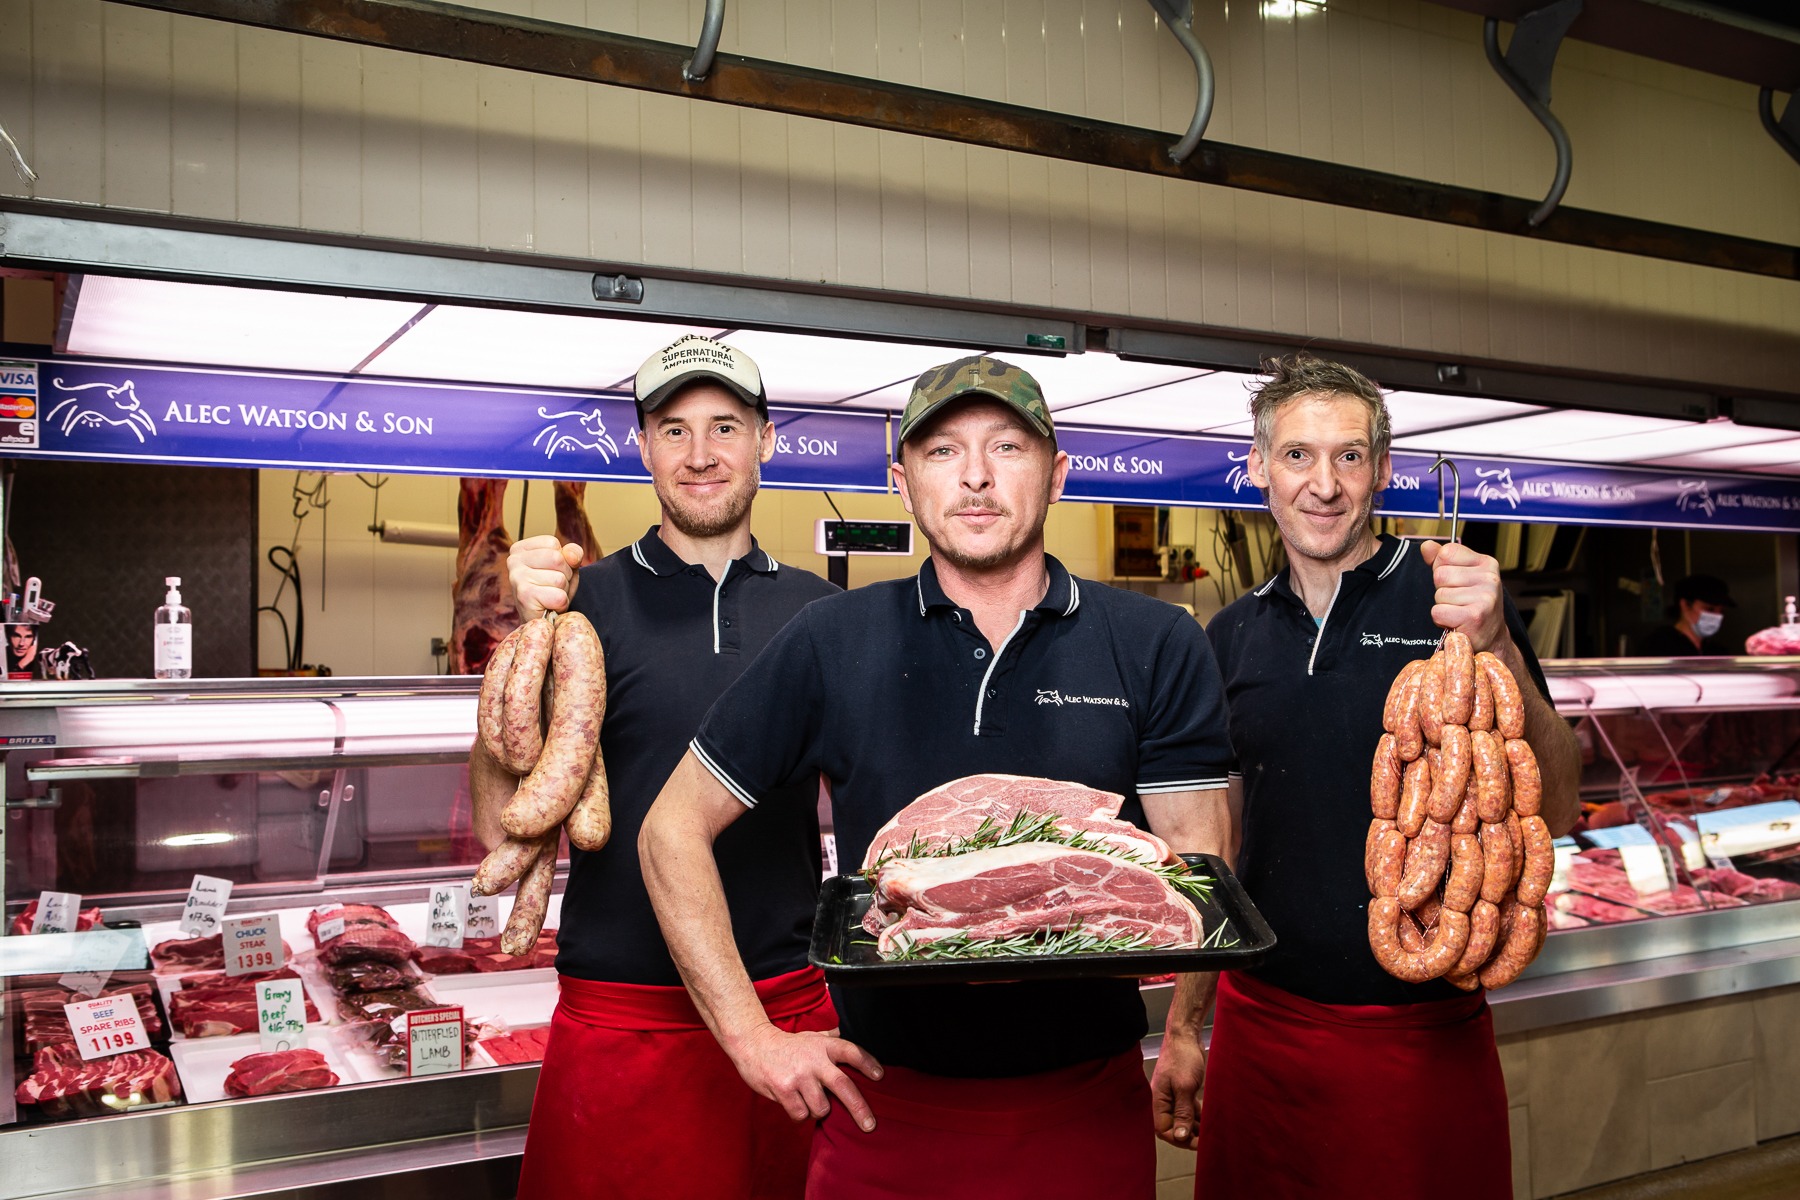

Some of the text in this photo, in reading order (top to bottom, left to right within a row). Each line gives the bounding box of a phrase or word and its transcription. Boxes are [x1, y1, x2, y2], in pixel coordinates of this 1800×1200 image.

[661, 348, 735, 364] SUPERNATURAL
[663, 357, 735, 371] AMPHITHEATRE
[0, 373, 35, 386] VISA
[163, 400, 433, 436] ALEC WATSON & SON
[776, 434, 838, 456] & SON
[1067, 454, 1163, 475] TSON & SON
[1392, 472, 1420, 490] SON
[1521, 479, 1636, 501] ALEC WATSON & SON
[1064, 695, 1081, 703] ALEC
[1082, 696, 1114, 705] WATSON
[1114, 698, 1121, 706] &
[235, 928, 267, 938] CHUCK
[240, 940, 266, 949] STEAK
[265, 988, 291, 1003] Gravy
[88, 1000, 113, 1008] QUALITY
[93, 1009, 115, 1019] BEEF
[262, 1004, 287, 1023] Beef
[440, 1010, 460, 1021] SPECIAL
[80, 1018, 136, 1034] SPARE RIBS
[420, 1045, 450, 1060] LAMB
